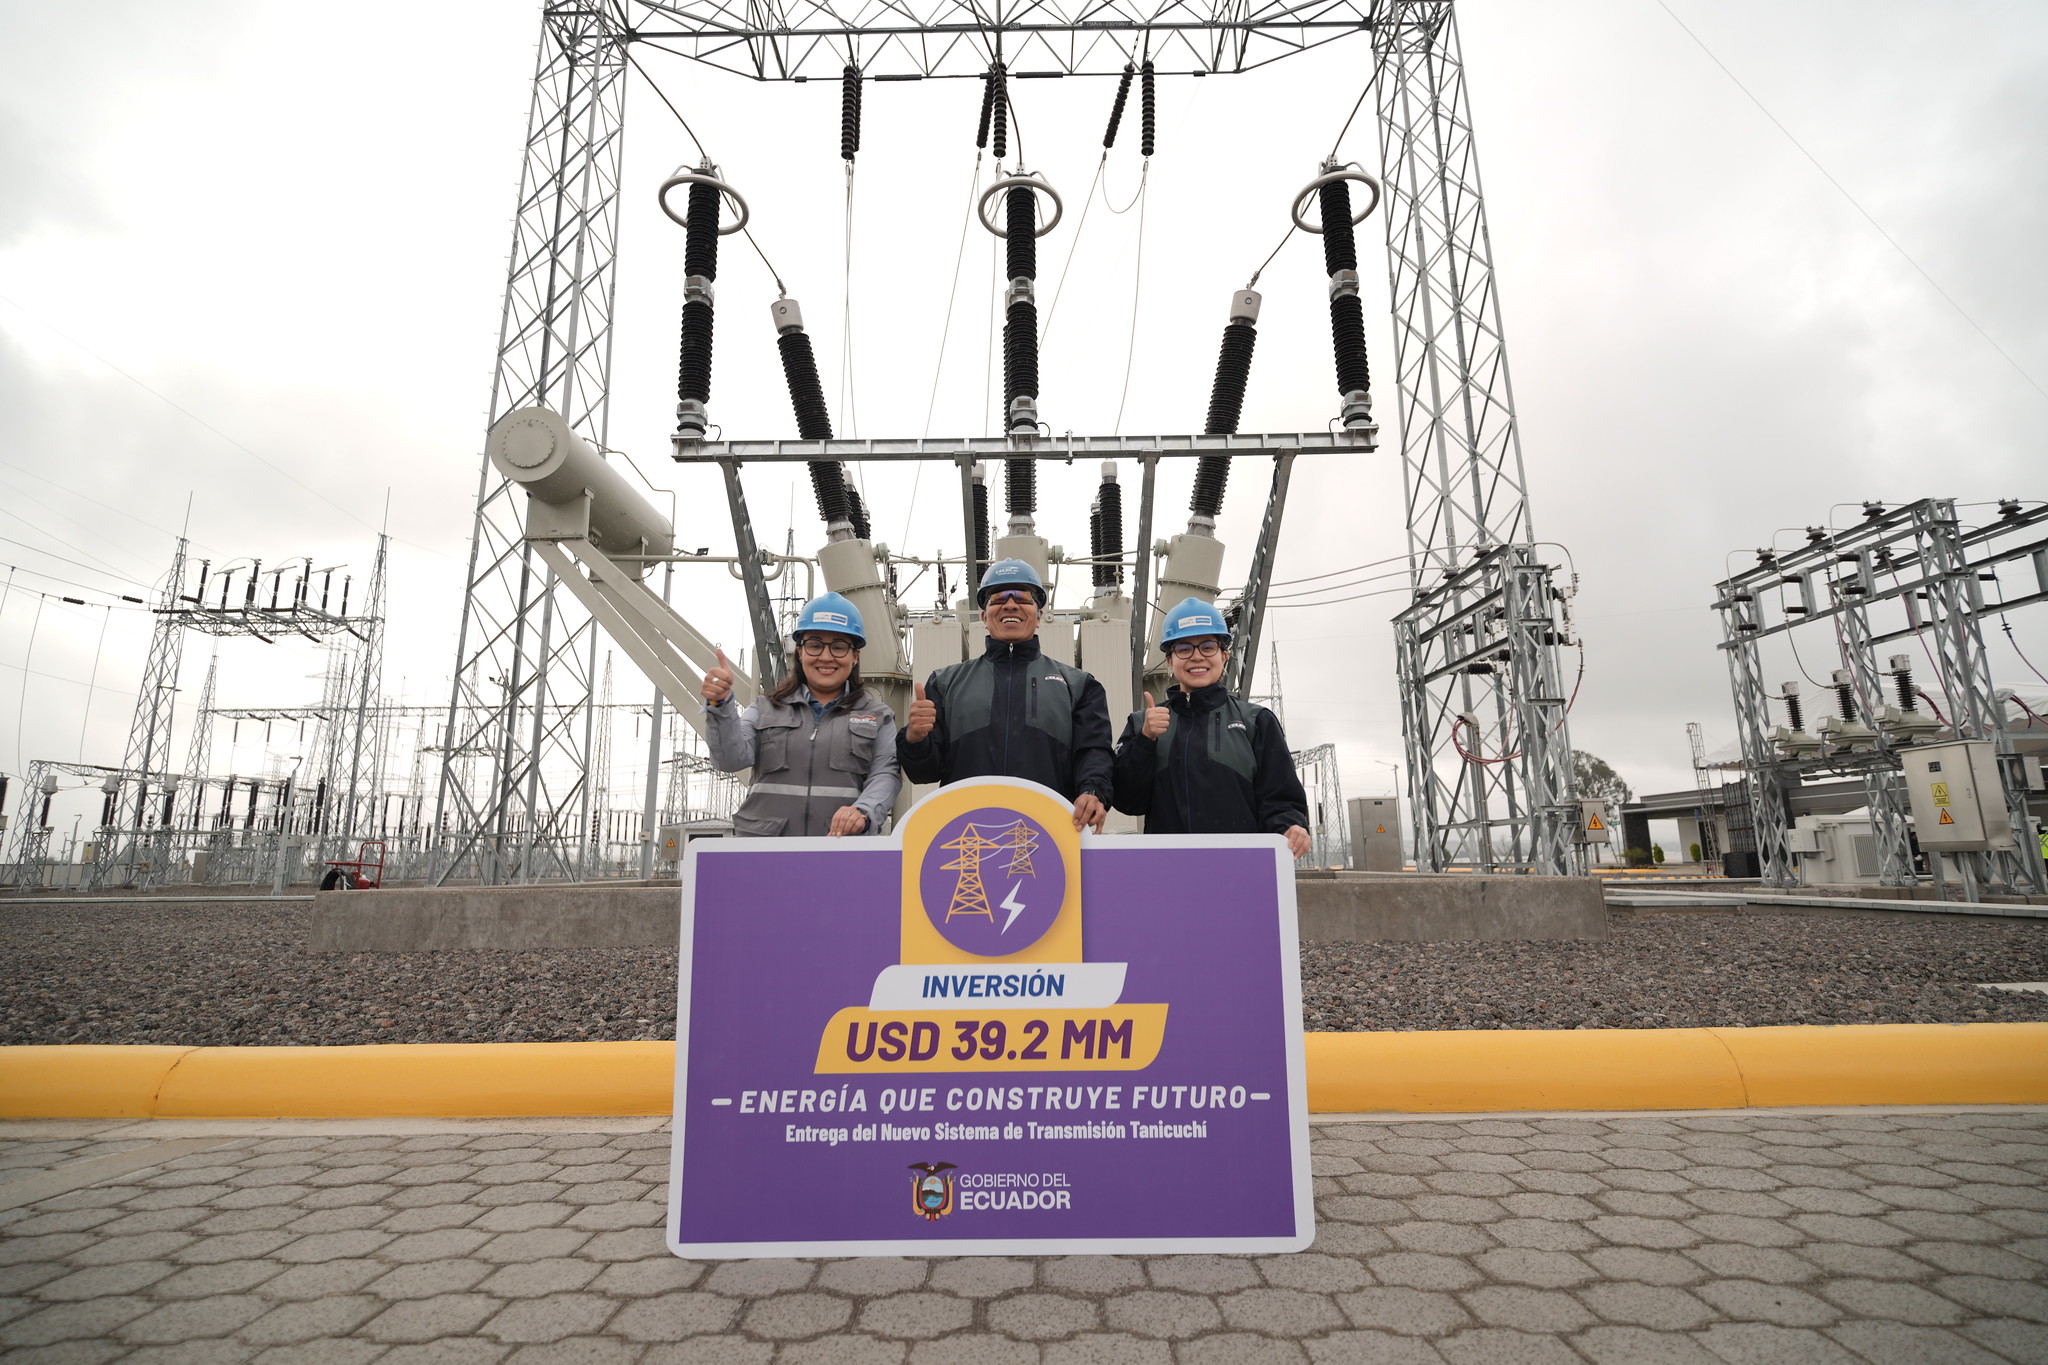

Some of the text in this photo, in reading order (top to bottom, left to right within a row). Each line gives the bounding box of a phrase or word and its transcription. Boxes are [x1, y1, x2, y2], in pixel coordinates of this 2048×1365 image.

[922, 968, 1065, 998] INVERSIÓN
[846, 1019, 1134, 1063] USD 39.2 MM
[739, 1084, 1247, 1115] ENERGÍA QUE CONSTRUYE FUTURO
[785, 1120, 1207, 1146] Entrega del Nuevo Sistema de Transmisión Tanicuchí
[959, 1173, 1072, 1188] GOBIERNO DEL
[959, 1190, 1072, 1210] ECUADOR
